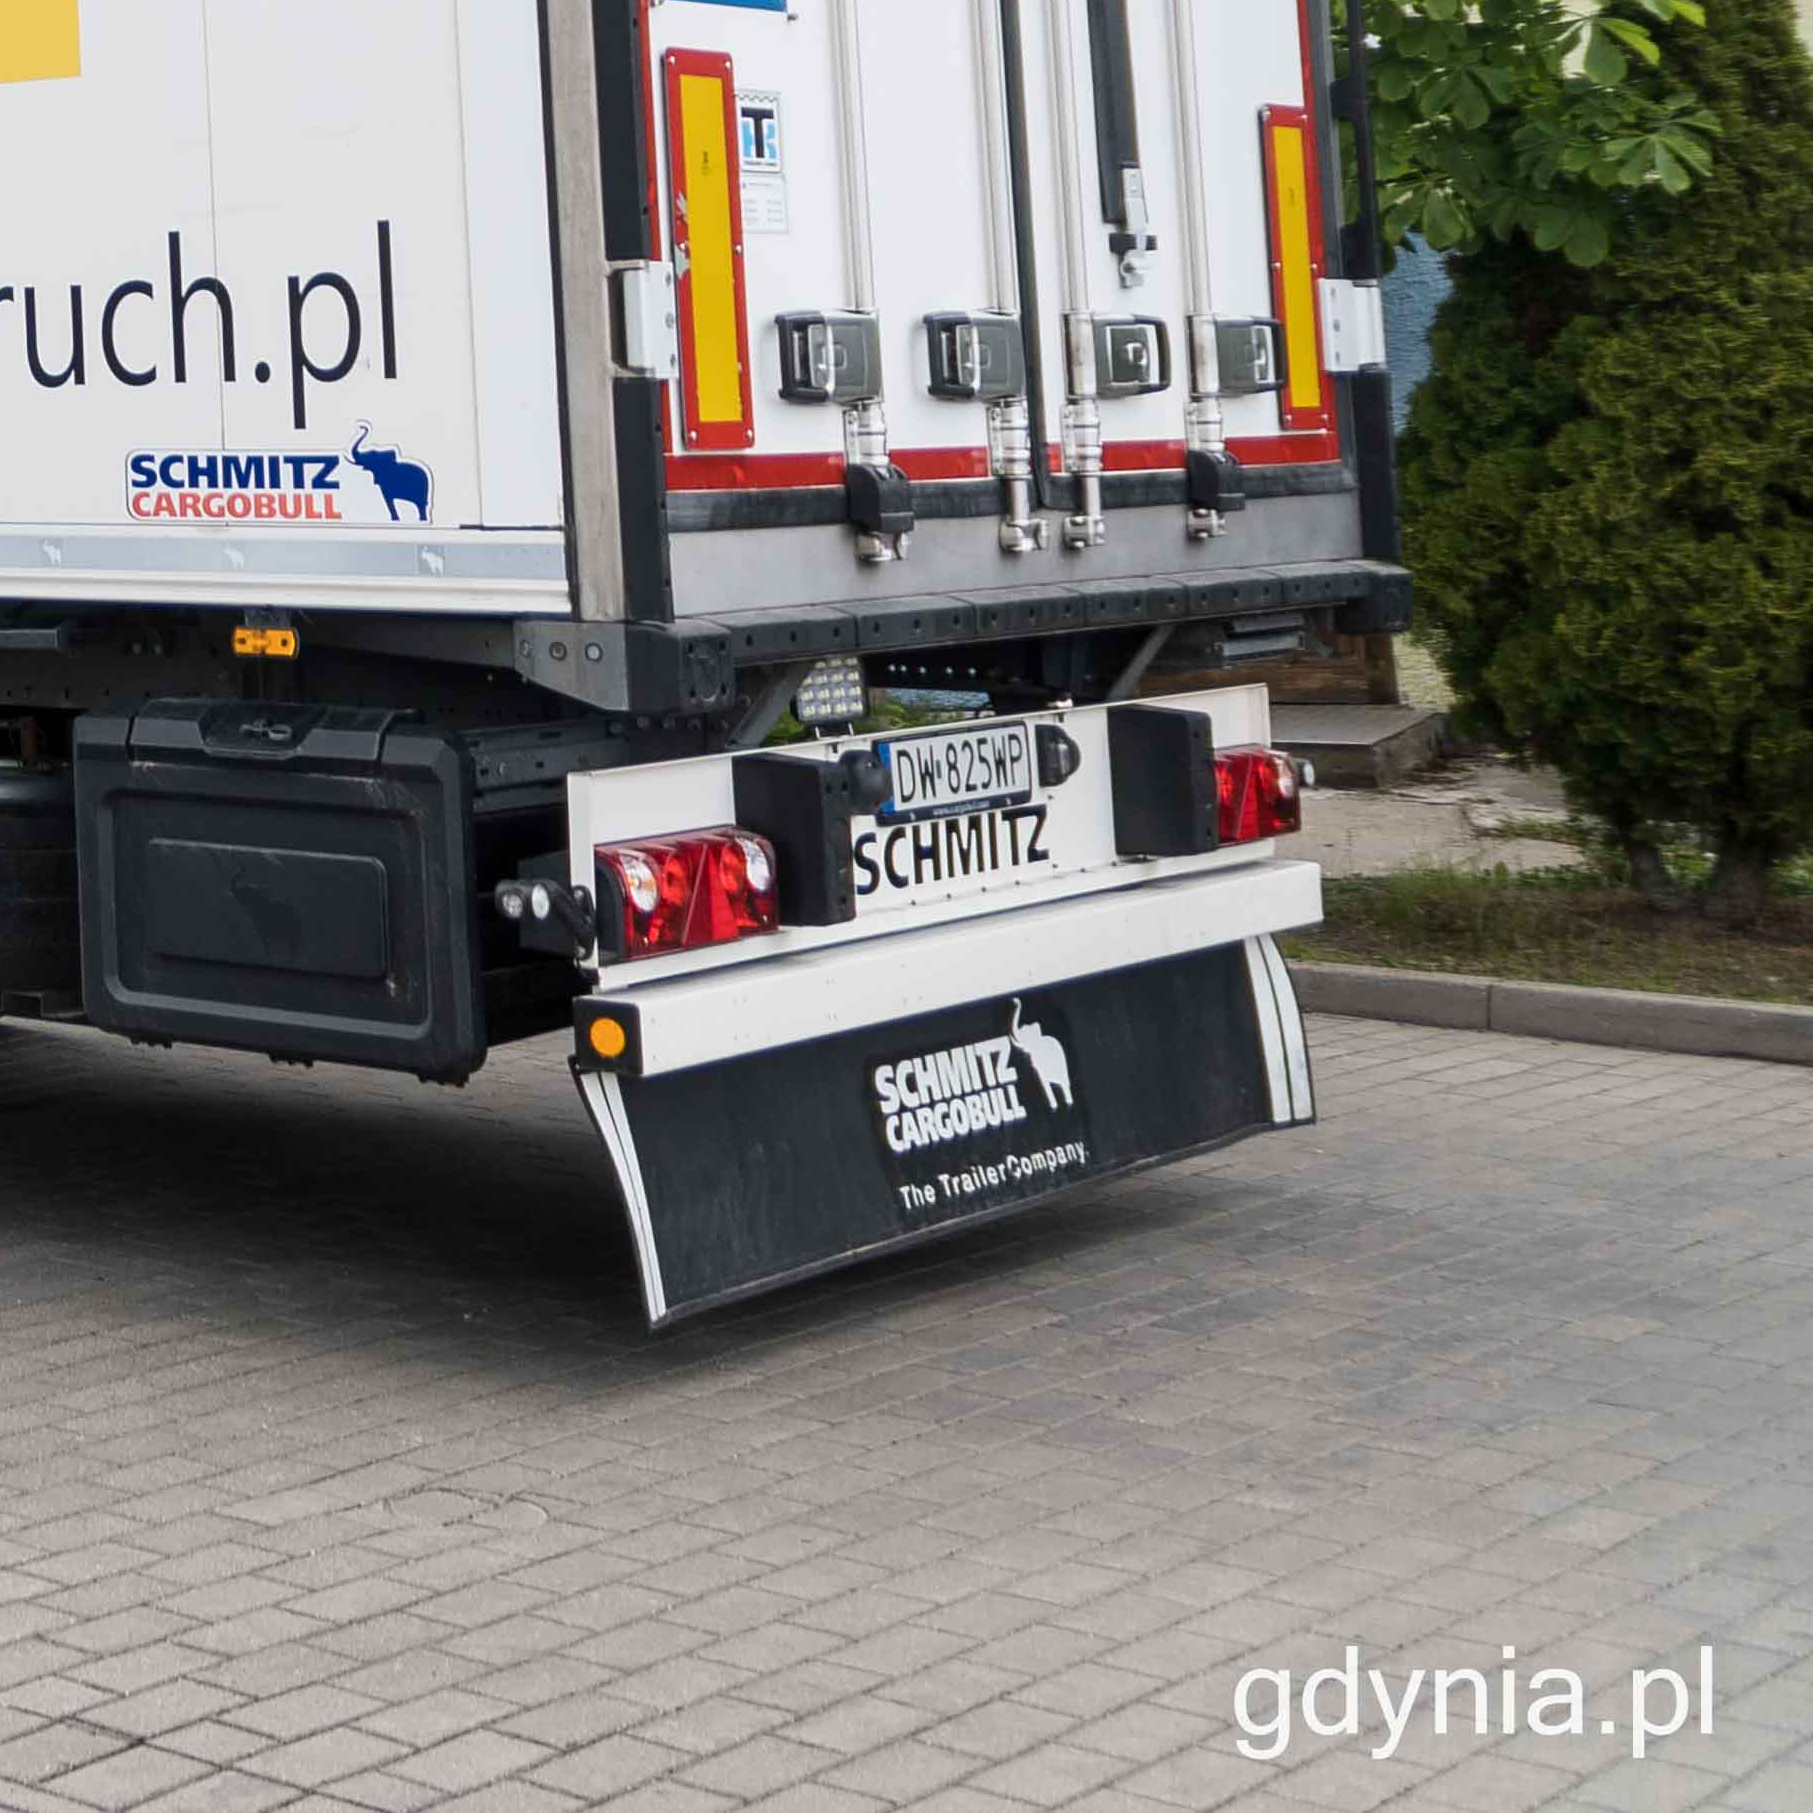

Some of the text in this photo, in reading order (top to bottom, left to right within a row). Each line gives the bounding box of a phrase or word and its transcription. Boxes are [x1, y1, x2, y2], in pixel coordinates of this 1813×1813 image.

[130, 454, 340, 489] SCHMITZ
[131, 491, 342, 520] CARGOBULL
[854, 804, 1050, 896] SCHMITZ
[875, 1036, 1018, 1115] SCHMITZ
[885, 1085, 1028, 1153] CARGOBULL
[899, 1185, 937, 1210] The
